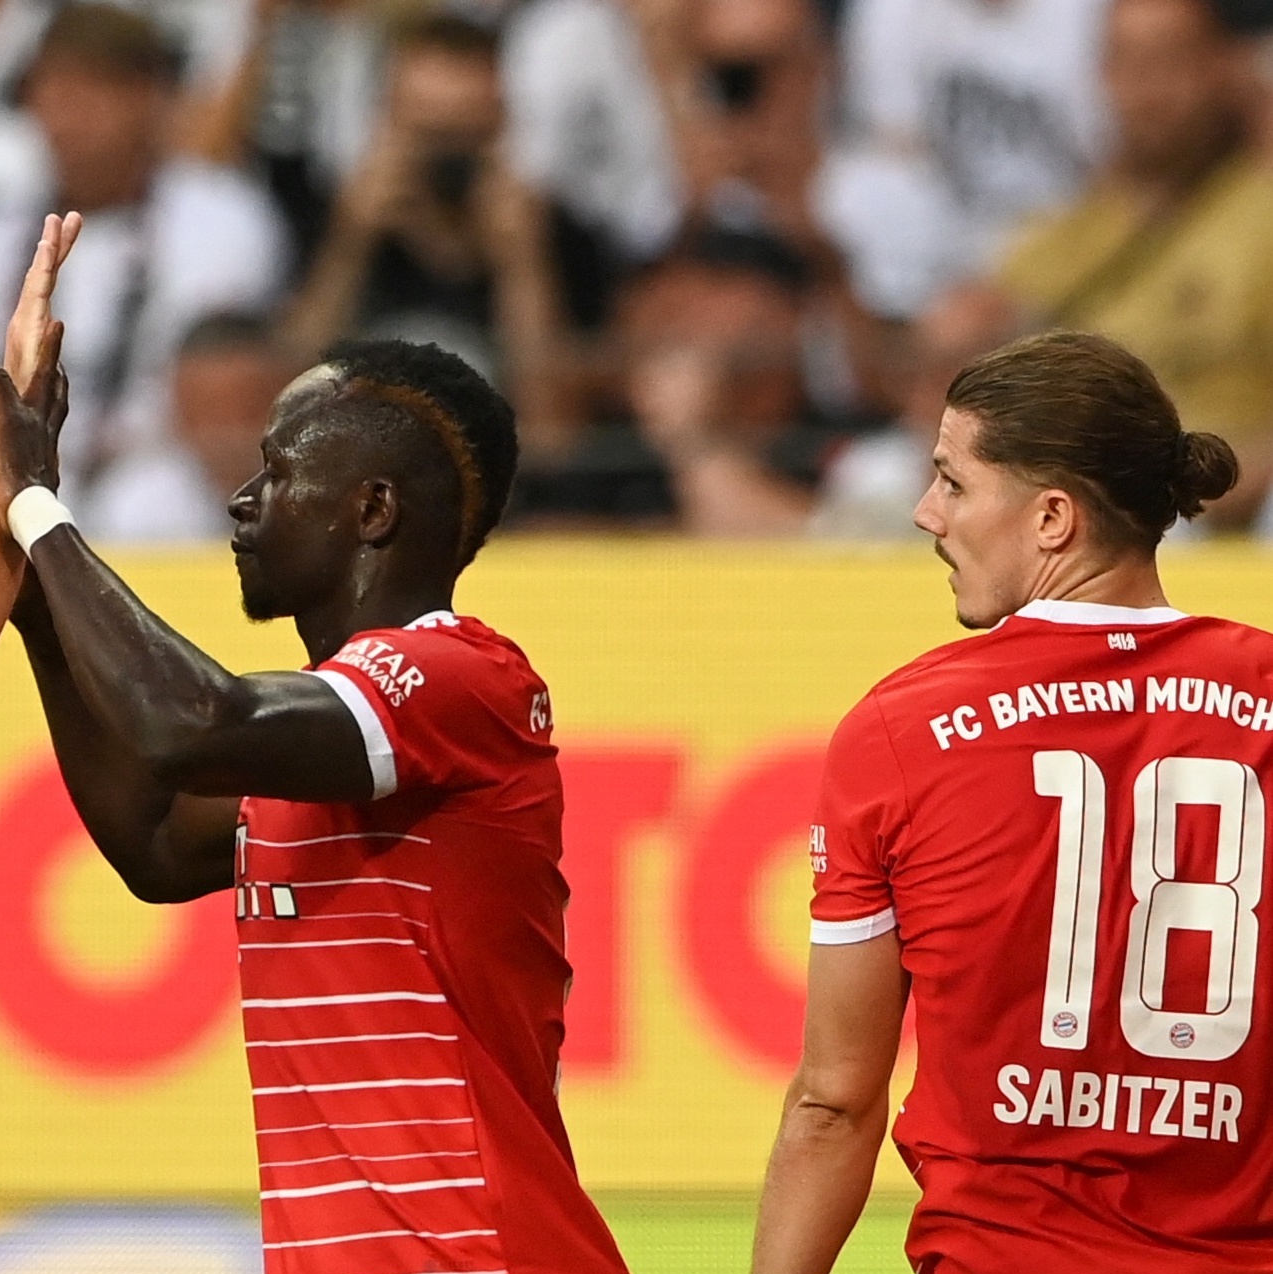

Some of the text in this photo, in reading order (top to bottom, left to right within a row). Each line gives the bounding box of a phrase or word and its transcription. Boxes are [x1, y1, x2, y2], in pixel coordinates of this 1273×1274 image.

[333, 640, 425, 698] ATAR
[929, 676, 1273, 750] FC BAYERN MÜNCH
[1031, 748, 1266, 1062] 18
[993, 1063, 1243, 1143] SABITZER
